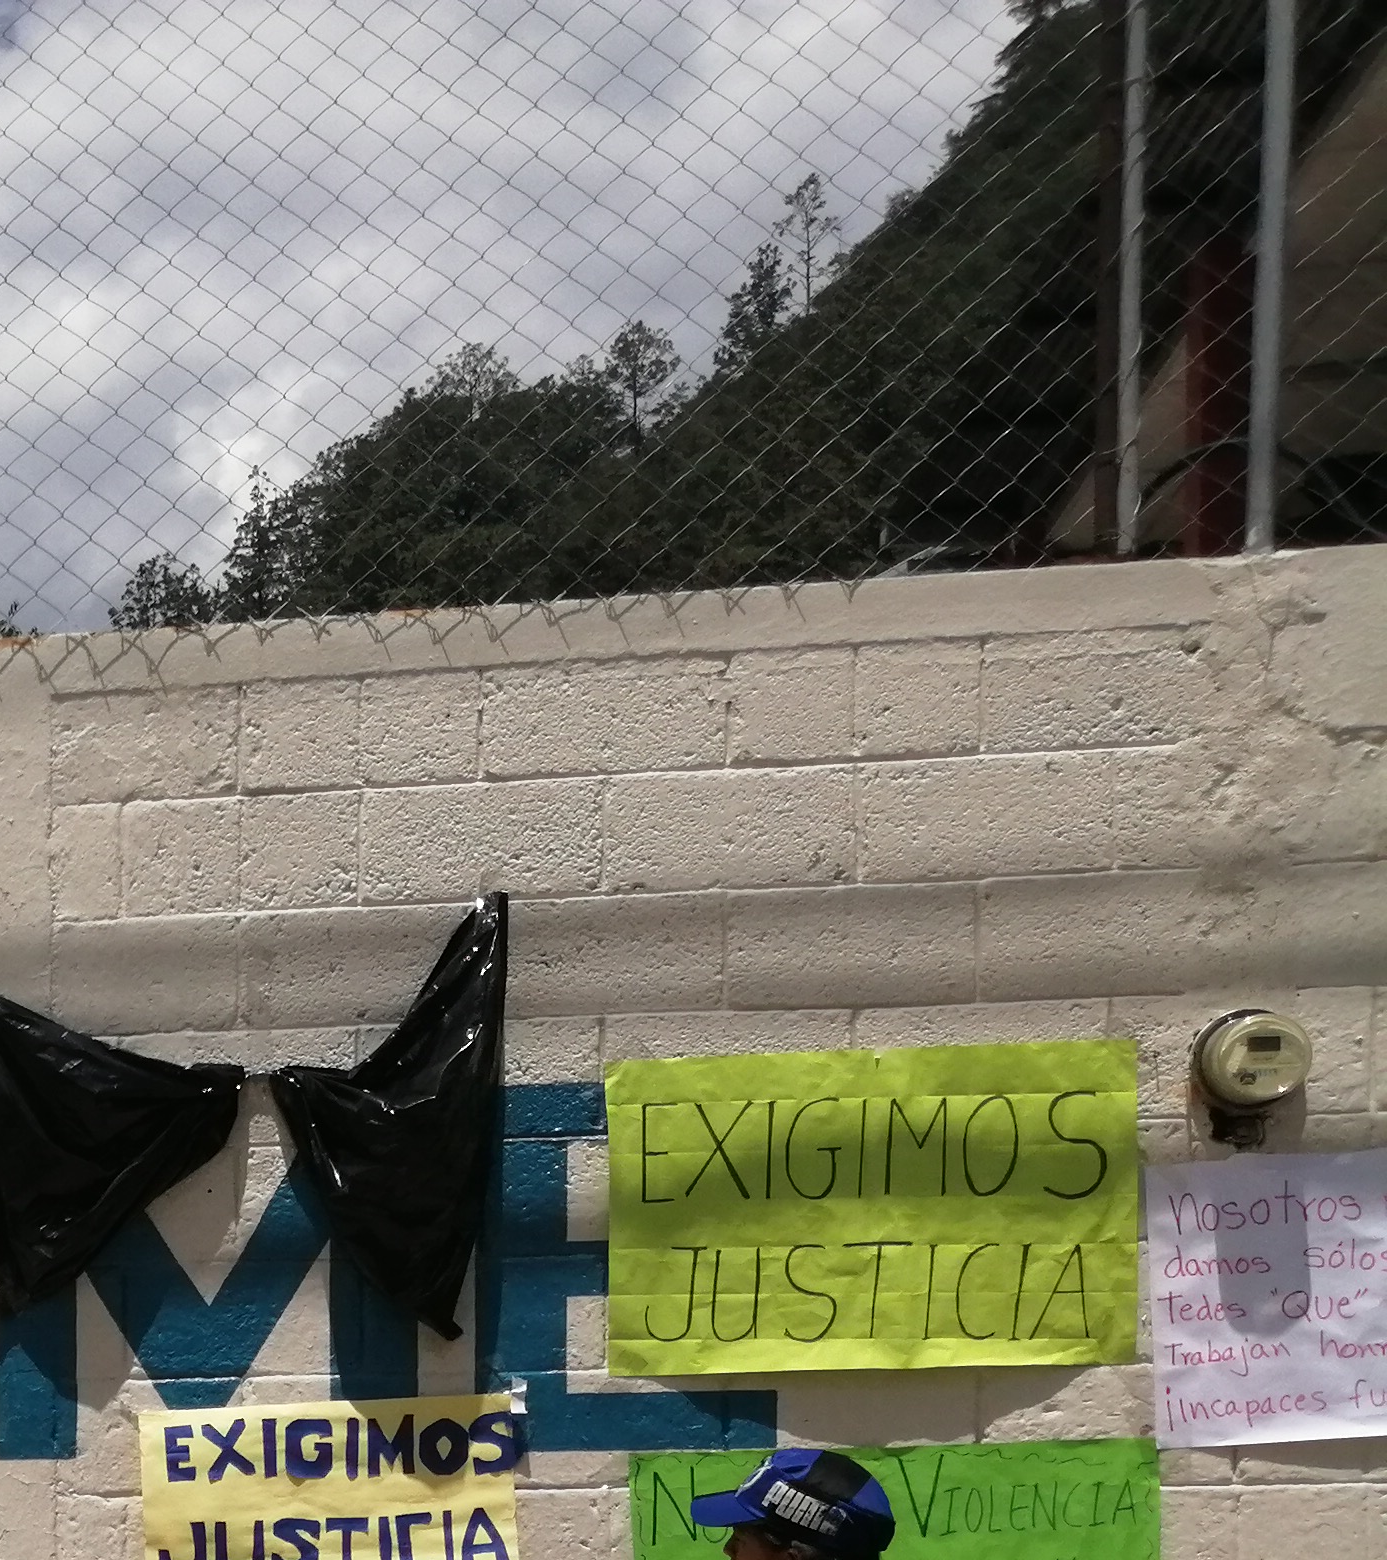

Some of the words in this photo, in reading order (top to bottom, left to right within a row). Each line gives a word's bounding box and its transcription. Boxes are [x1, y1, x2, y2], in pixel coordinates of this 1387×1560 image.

[639, 1089, 1109, 1204] EXIGIMOS
[644, 1240, 1093, 1344] JUSTICIA
[1163, 1244, 1272, 1279] damos
[1164, 1337, 1291, 1377] Trabajan
[162, 1410, 527, 1483] EXIGIMOS
